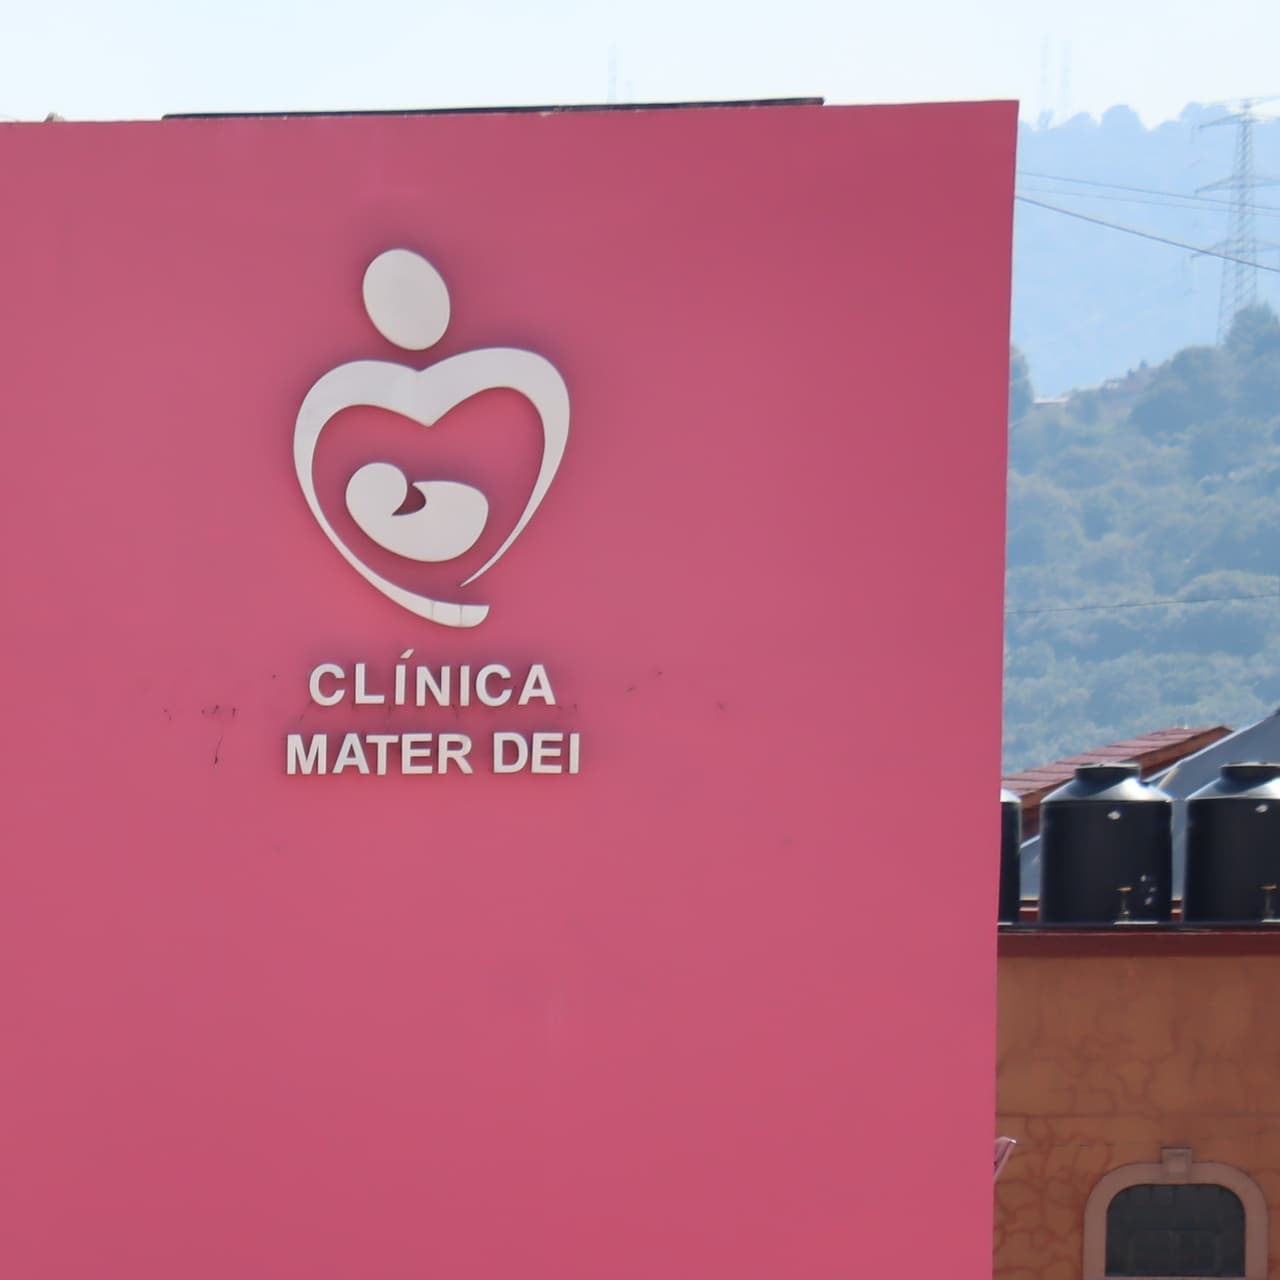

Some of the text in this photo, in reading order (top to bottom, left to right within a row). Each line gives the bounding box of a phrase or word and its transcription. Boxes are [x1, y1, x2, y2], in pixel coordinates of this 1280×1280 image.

[308, 648, 557, 707] CLÍNICA
[286, 731, 581, 776] MATER DEI
